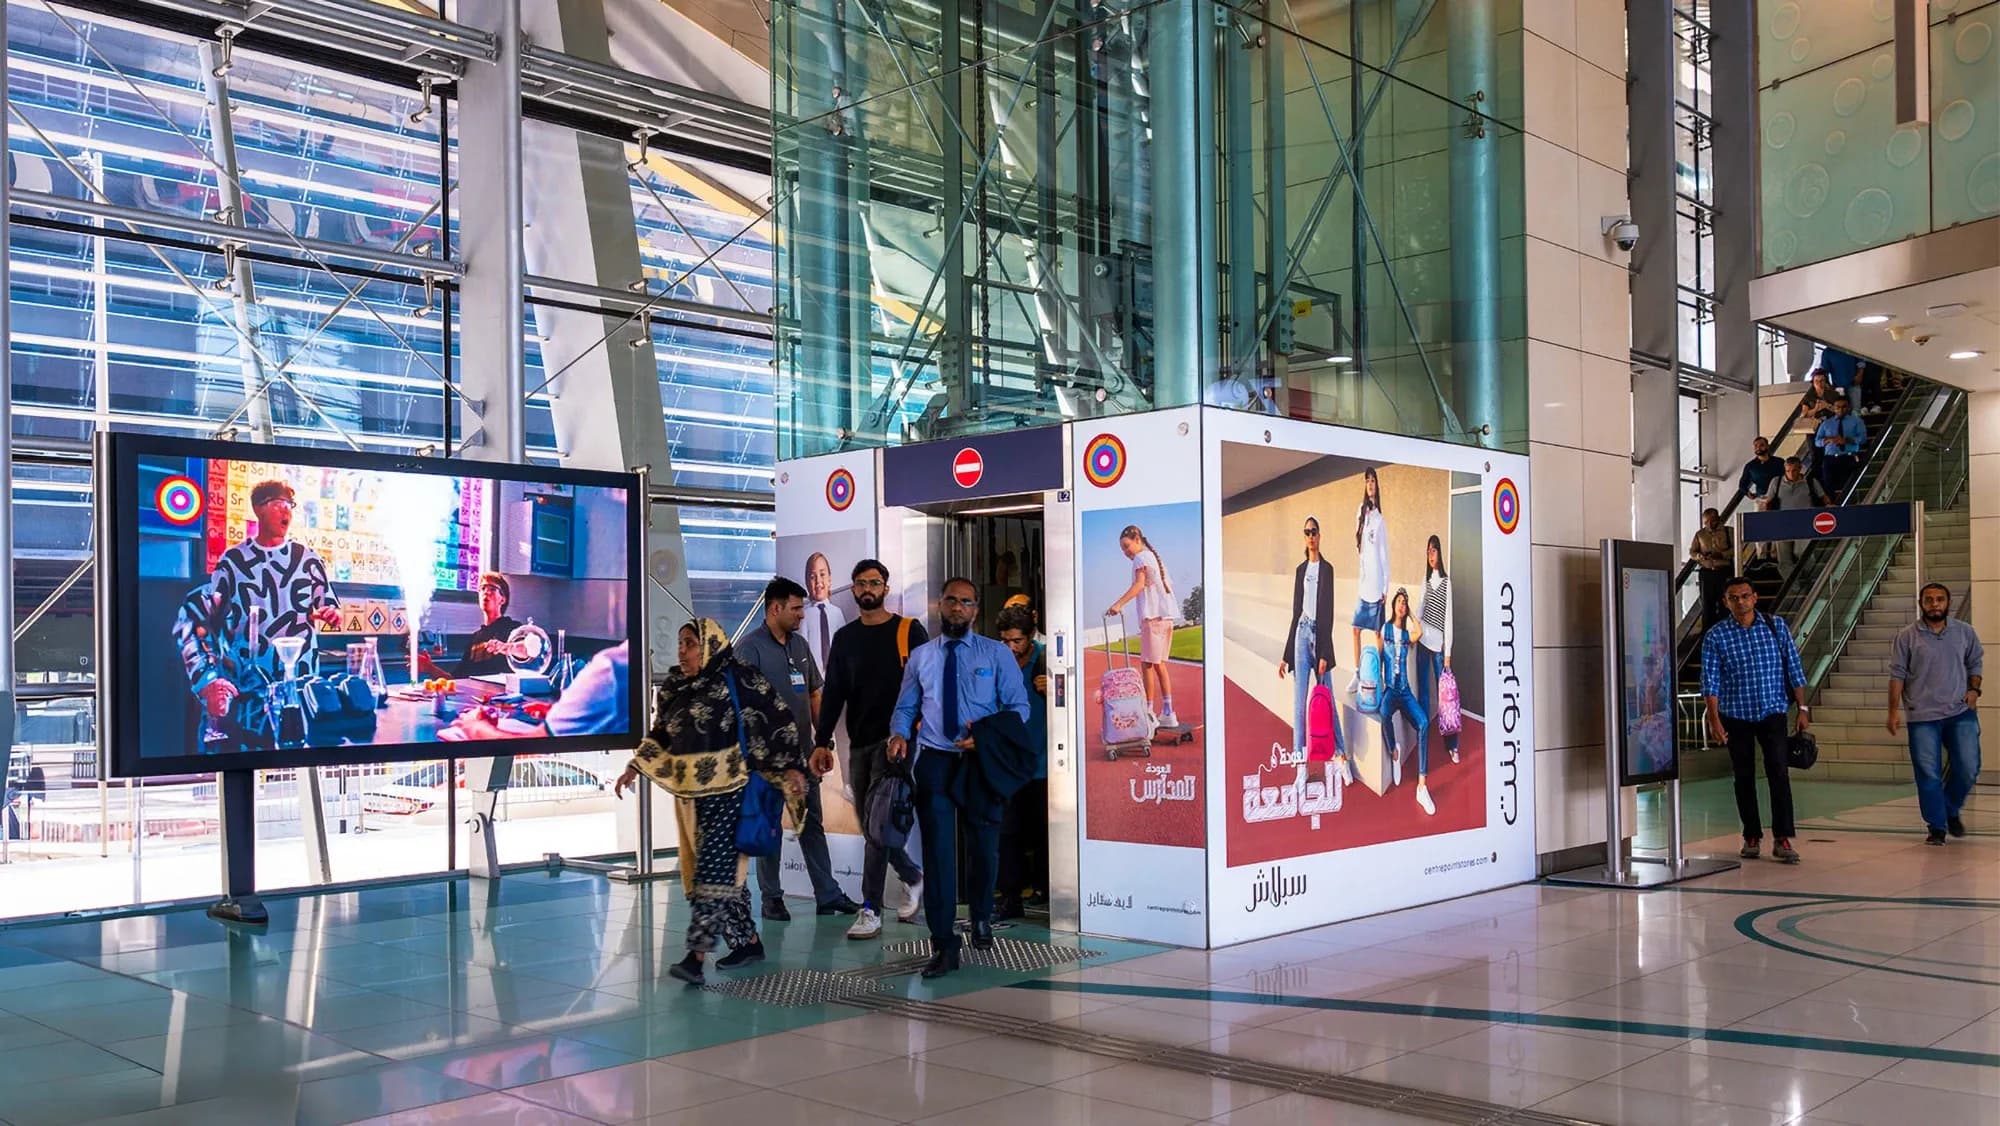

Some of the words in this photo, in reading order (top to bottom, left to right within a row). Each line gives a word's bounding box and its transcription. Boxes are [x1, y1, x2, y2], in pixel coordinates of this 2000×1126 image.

[1499, 582, 1520, 826] سنتربوينت
[1129, 774, 1196, 805] للمدارس
[1145, 762, 1172, 775] العودة
[1242, 761, 1343, 830] للجامعة
[1246, 866, 1307, 912] سبلاش
